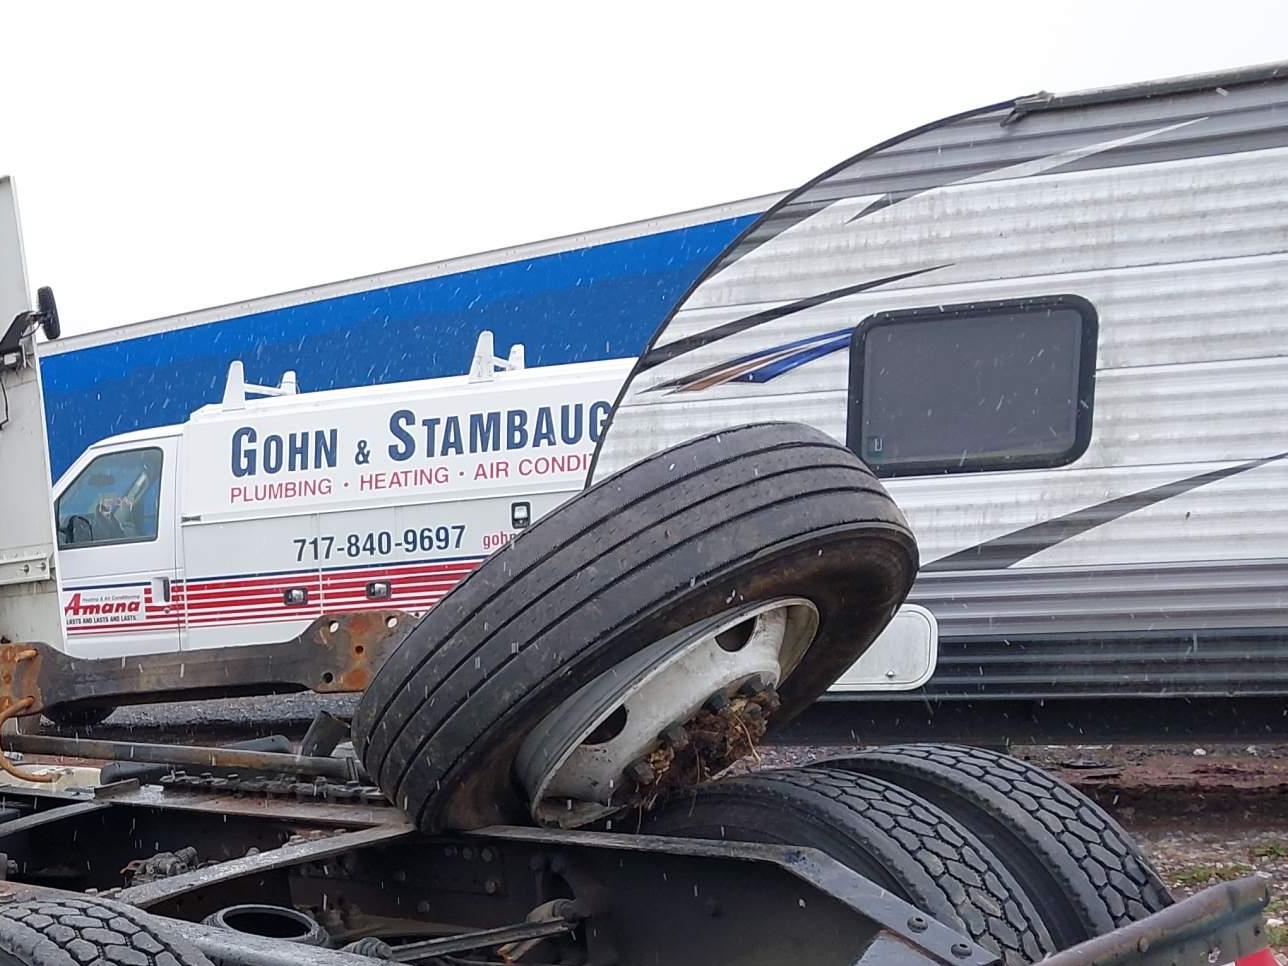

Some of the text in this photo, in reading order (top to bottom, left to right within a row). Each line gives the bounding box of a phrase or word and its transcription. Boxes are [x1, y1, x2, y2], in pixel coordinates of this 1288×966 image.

[231, 400, 612, 478] GOHN & STAMBAUG
[230, 478, 332, 503] PLUMBING
[360, 466, 449, 491] HEATING
[473, 461, 509, 480] AIR
[293, 525, 465, 562] 717-840-9697
[64, 592, 140, 616] Amana
